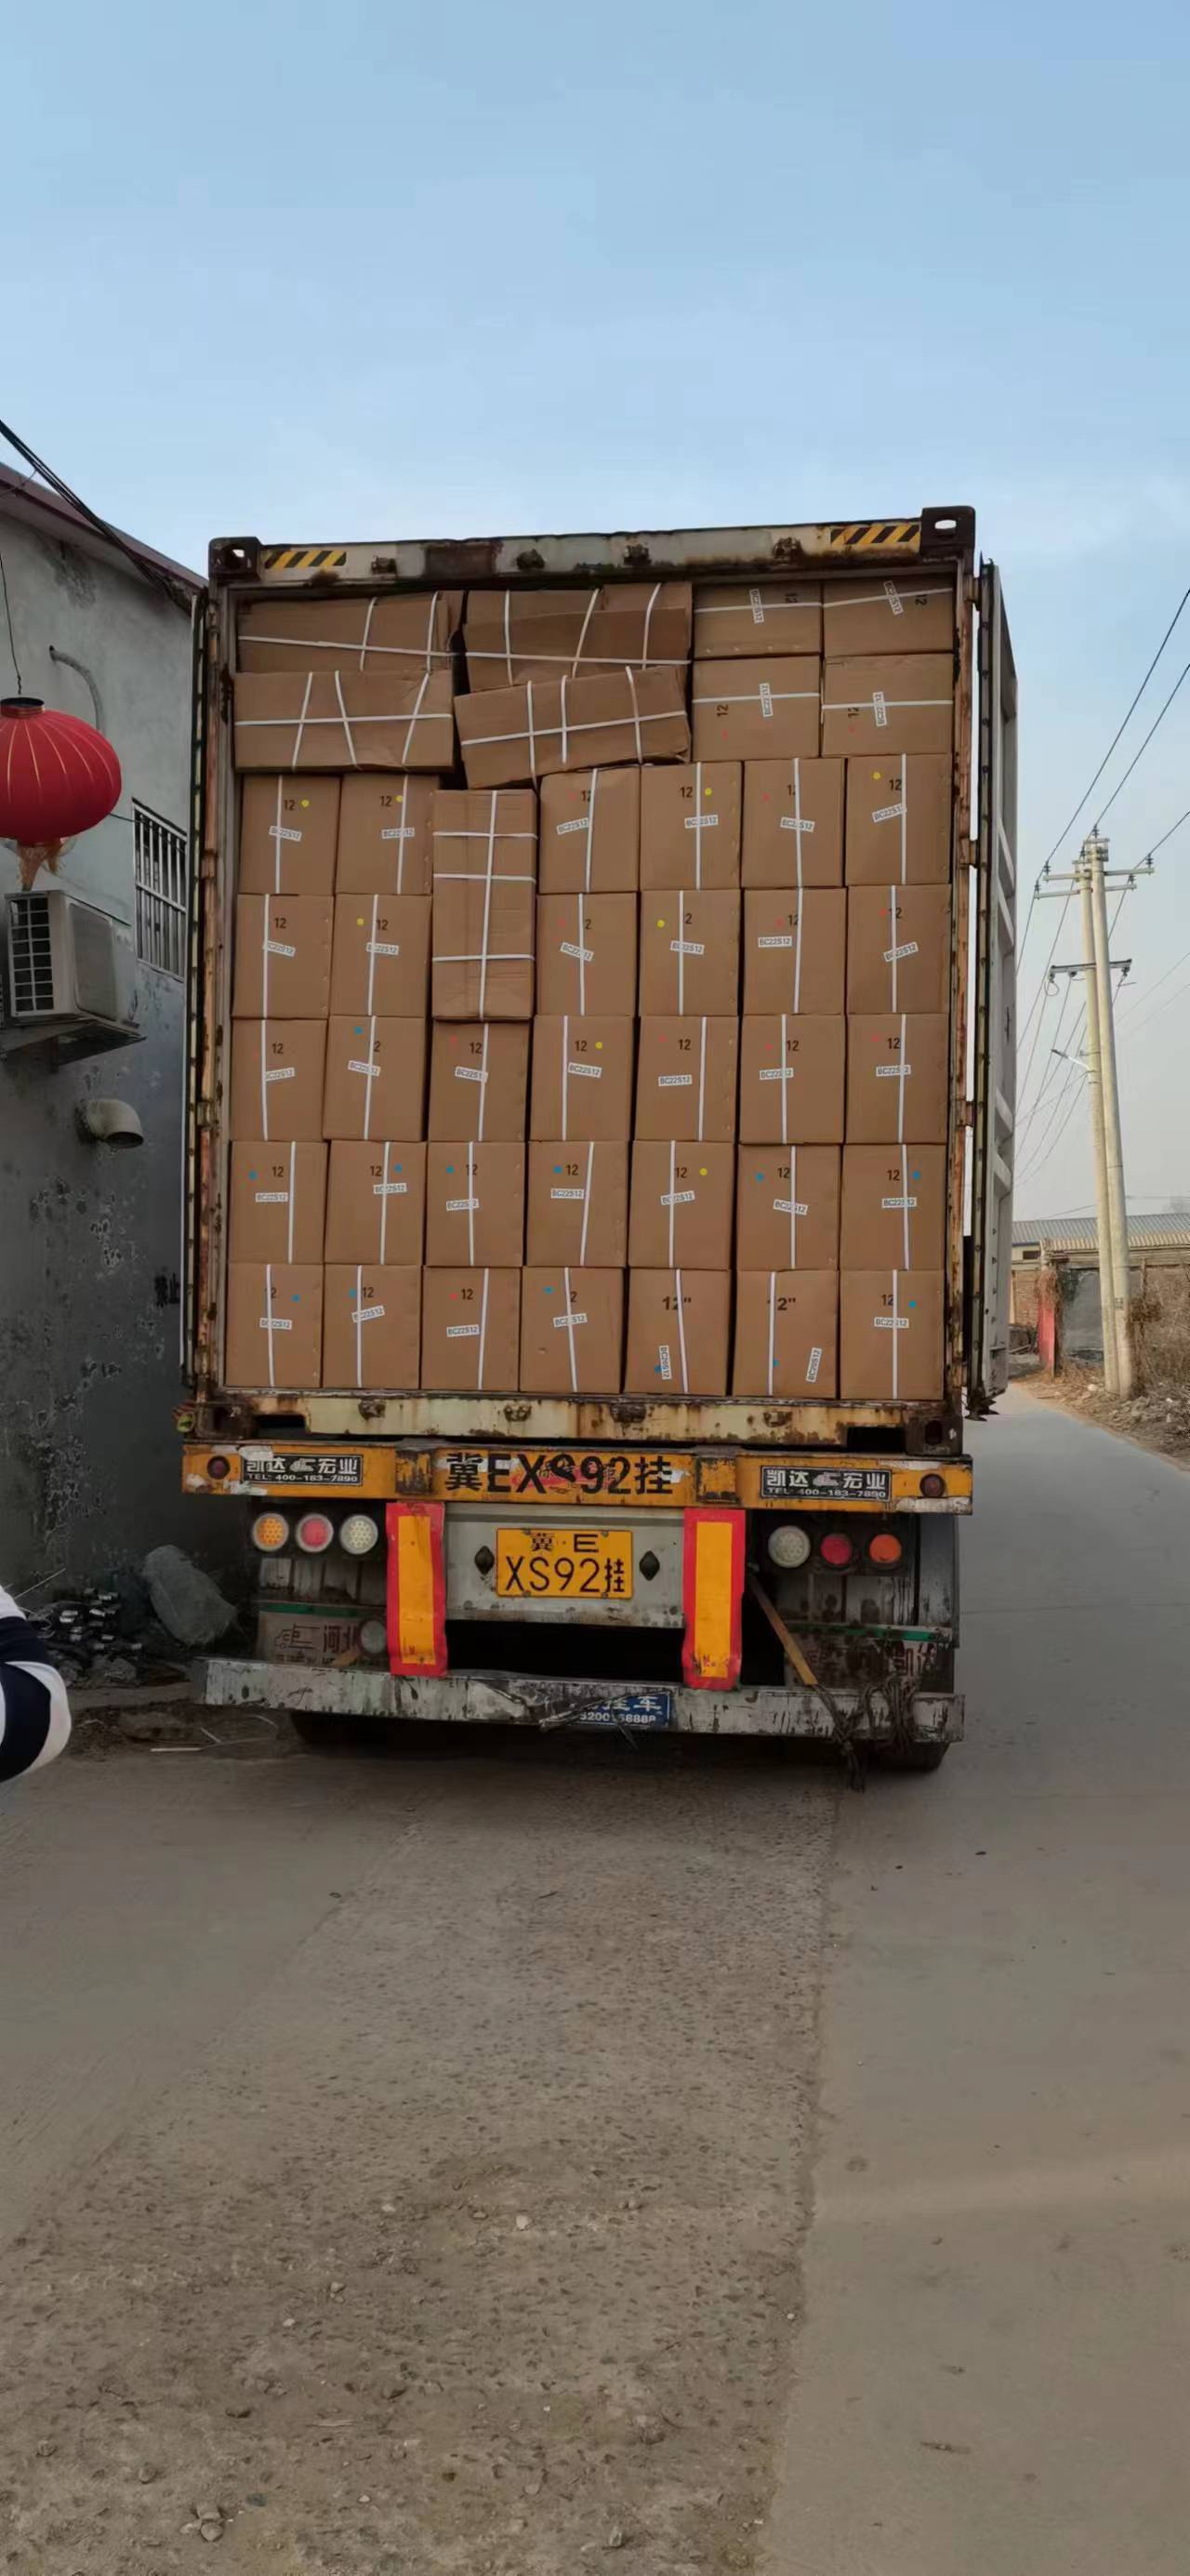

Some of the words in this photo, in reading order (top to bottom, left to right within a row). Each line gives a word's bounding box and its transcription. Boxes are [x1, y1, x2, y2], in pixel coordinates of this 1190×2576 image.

[716, 704, 729, 717] 12
[847, 707, 859, 718] 12
[889, 779, 902, 790] 12
[681, 787, 693, 798] 12
[284, 800, 296, 811] 12
[379, 795, 392, 806] 12
[274, 917, 286, 928] 12
[759, 936, 791, 947] BC22S12
[271, 1043, 284, 1055] 12
[469, 1042, 483, 1054] 12
[575, 1041, 588, 1051] 12
[678, 1040, 692, 1051] 12
[787, 1041, 800, 1052] 12
[887, 1038, 900, 1049] 12
[569, 1063, 602, 1077] BC22S12
[659, 1075, 692, 1086] BC22S12
[271, 1166, 284, 1177] 12
[370, 1166, 382, 1177] 12
[566, 1164, 578, 1175] 12
[675, 1167, 687, 1178] 12
[777, 1168, 790, 1179] 12
[887, 1170, 900, 1181] 12
[552, 1188, 584, 1198] BC22S12
[361, 1287, 374, 1298] 12
[461, 1289, 473, 1300] 12
[447, 1325, 479, 1336] BC22S12
[318, 1457, 357, 1474] 宏业
[766, 1469, 808, 1487] 凯达
[843, 1472, 885, 1490] 宏业
[505, 1556, 625, 1593] XS92挂
